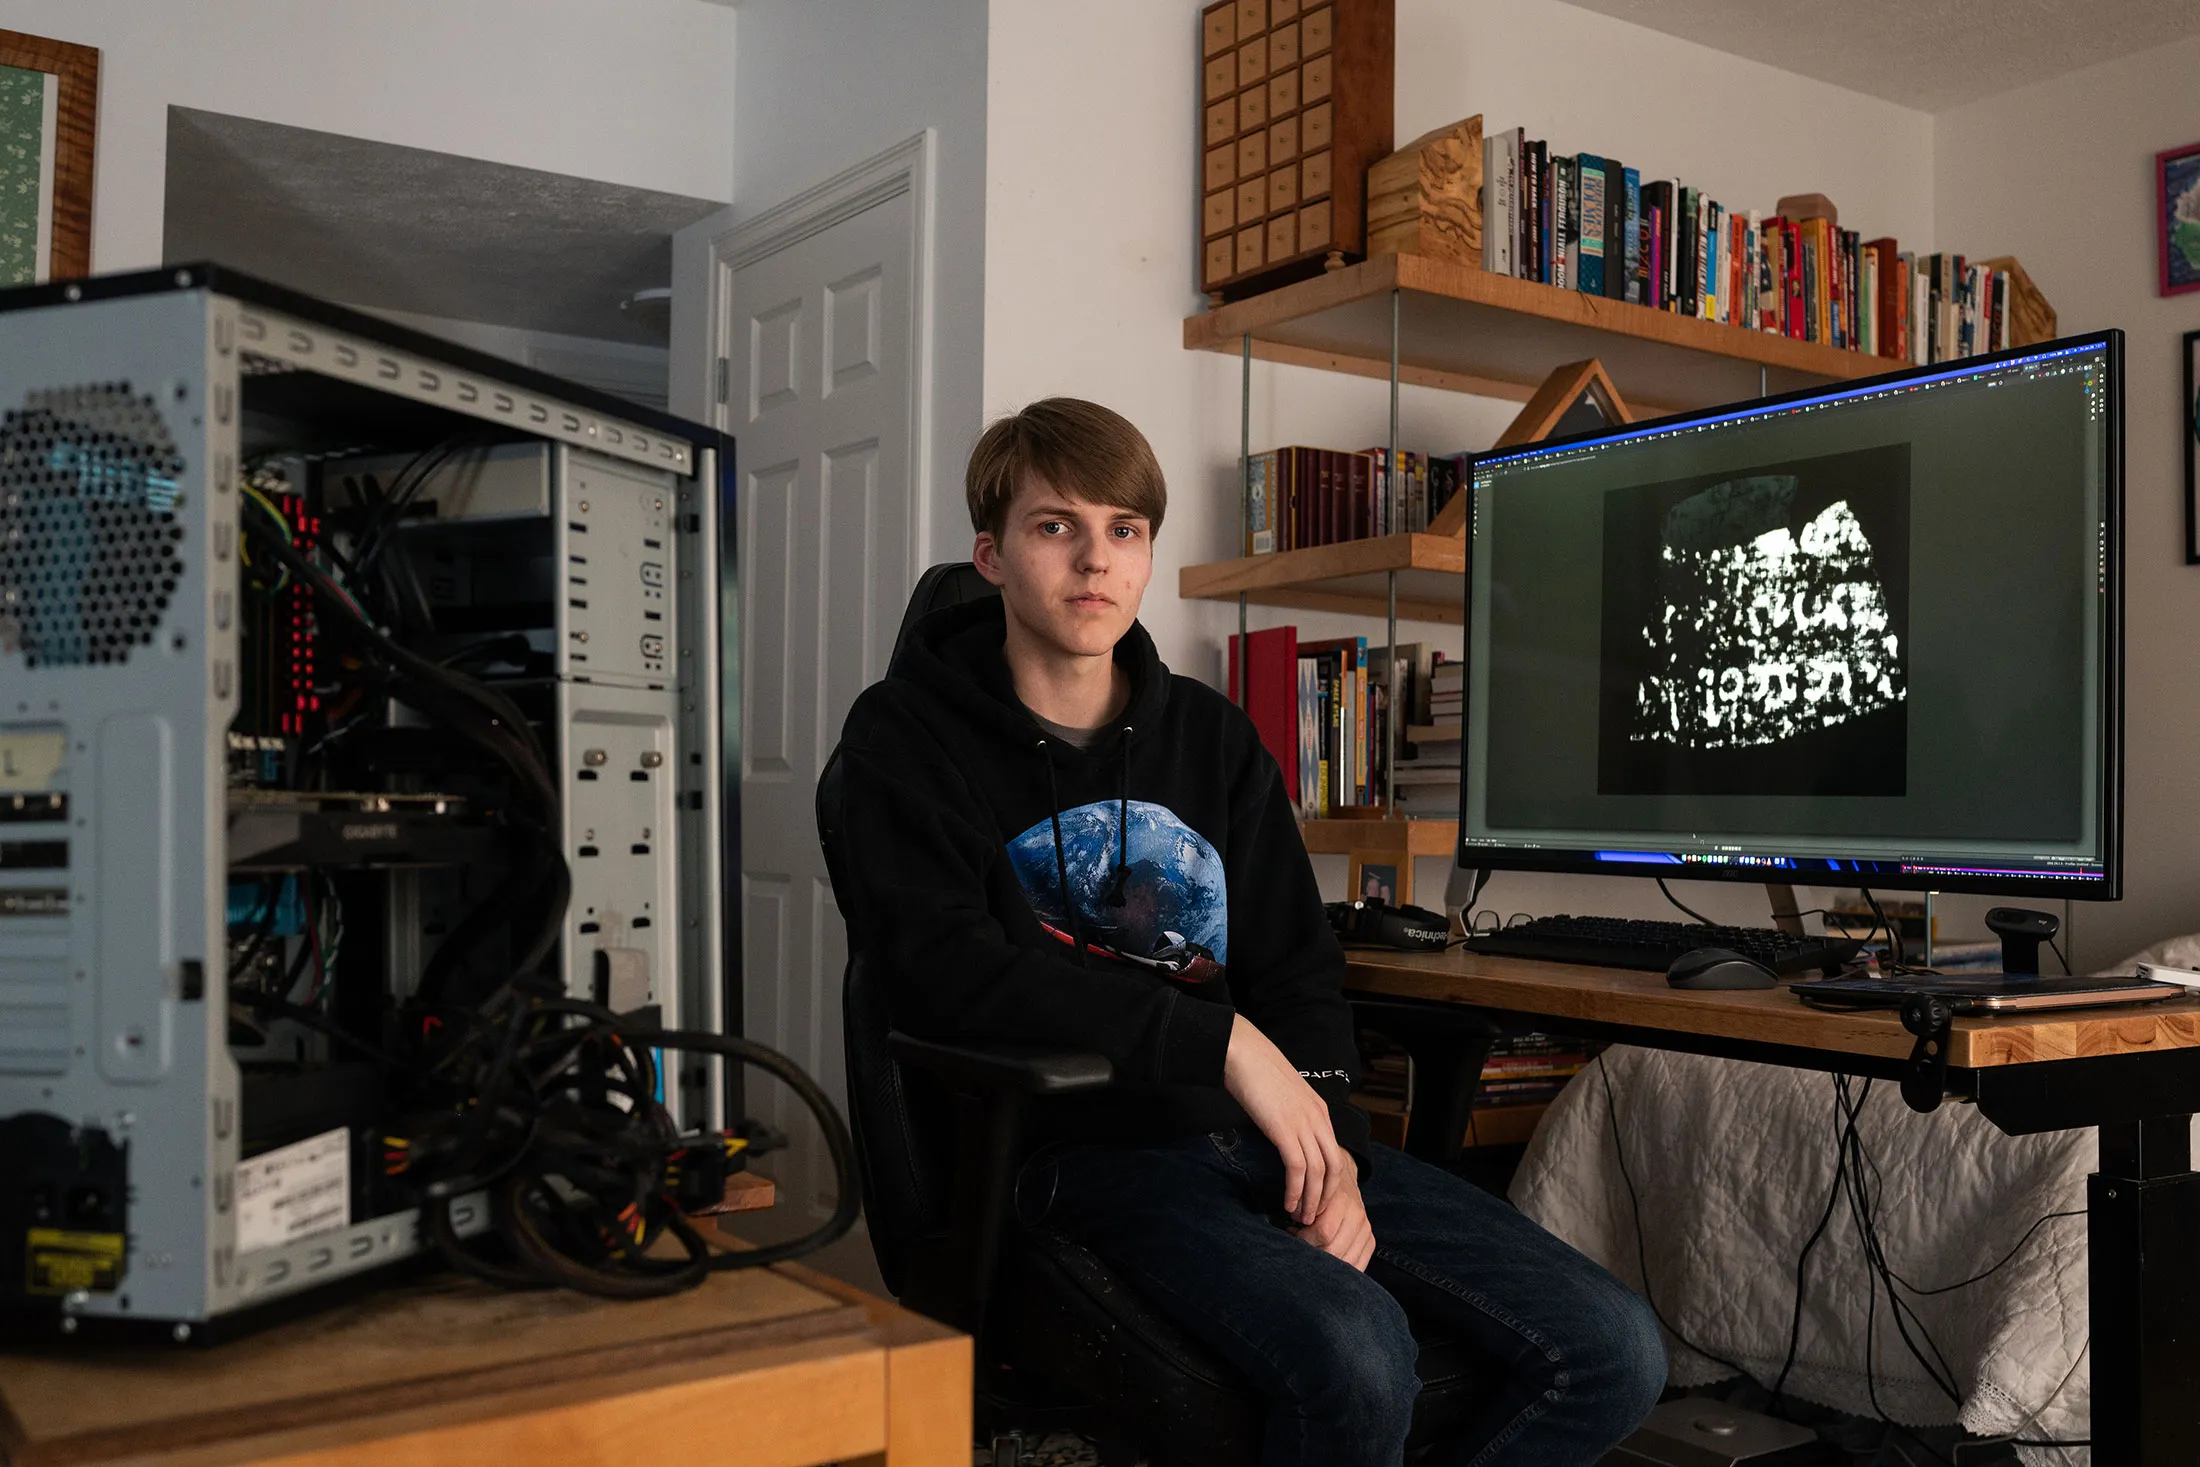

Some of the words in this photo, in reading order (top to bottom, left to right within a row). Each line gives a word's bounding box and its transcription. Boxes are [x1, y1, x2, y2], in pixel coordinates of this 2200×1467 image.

[1558, 180, 1566, 230] FERGUSON
[1583, 176, 1596, 236] HOLMES
[1595, 178, 1604, 236] SHERLOCK
[1558, 232, 1566, 258] NIALL
[343, 824, 399, 840] GIGABYTE
